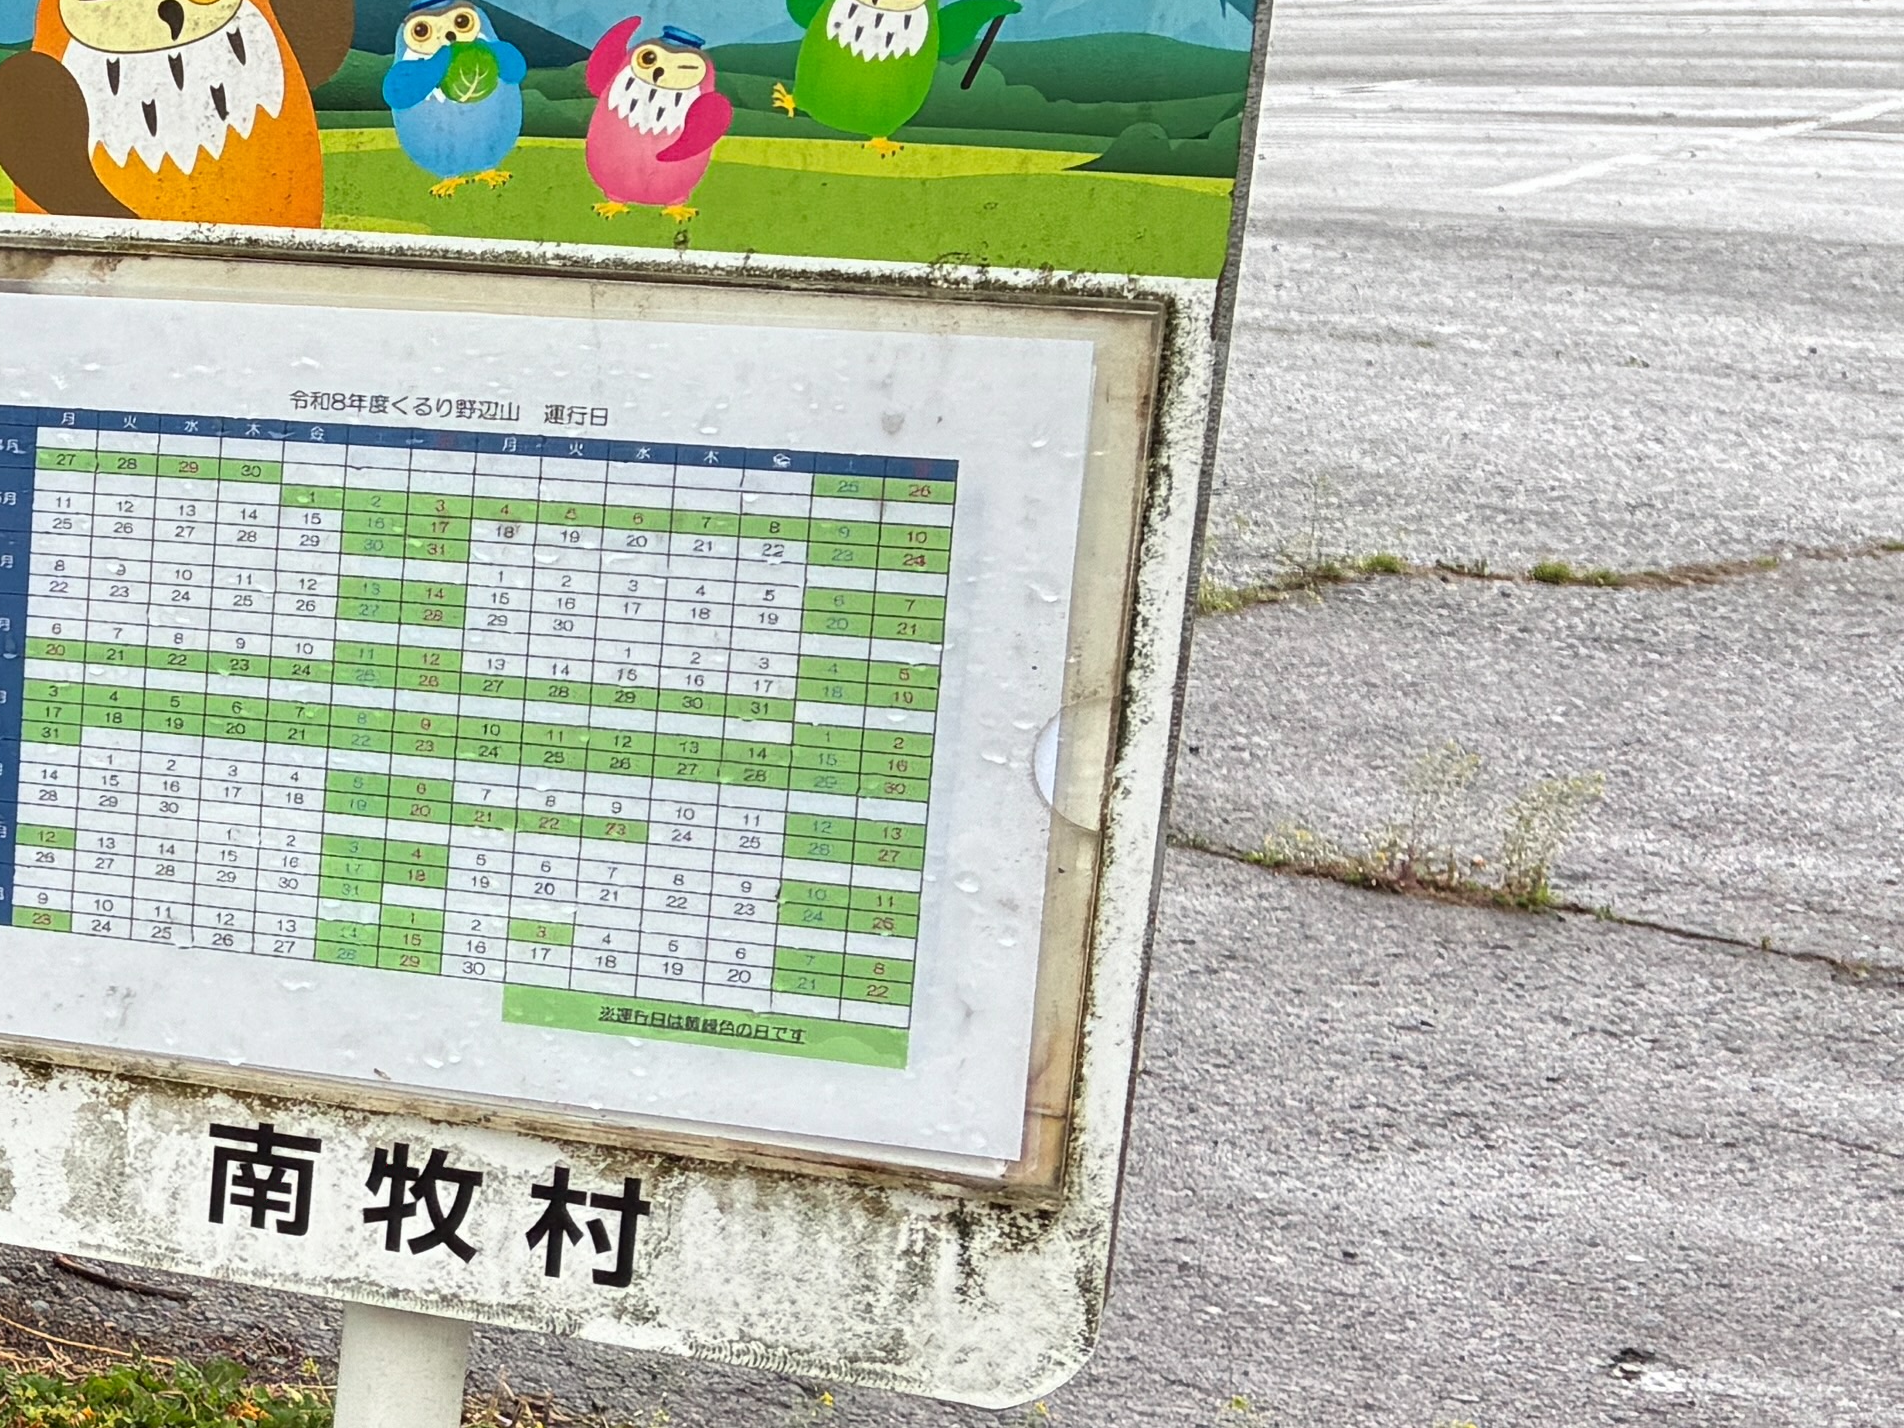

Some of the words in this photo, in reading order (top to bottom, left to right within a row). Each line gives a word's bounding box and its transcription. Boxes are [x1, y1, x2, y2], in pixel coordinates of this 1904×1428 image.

[288, 389, 520, 422] 令和8年度くるり野辺山
[543, 402, 610, 427] 運行日
[51, 516, 73, 530] 25
[112, 520, 134, 535] 26
[173, 524, 196, 538] 27
[236, 528, 258, 543] 28
[298, 533, 321, 548] 29
[55, 495, 71, 509] 11
[116, 499, 134, 514] 12
[178, 503, 197, 517] 13
[239, 507, 258, 521] 14
[303, 511, 322, 525] 15
[560, 529, 581, 544] 19
[625, 534, 648, 548] 20
[692, 538, 713, 553] 21
[760, 542, 784, 558] 22
[47, 579, 69, 594] 22
[108, 584, 130, 599] 23
[170, 588, 191, 603] 24
[232, 593, 254, 608] 25
[295, 598, 316, 613] 26
[486, 612, 508, 627] 29
[551, 618, 575, 633] 30
[53, 558, 66, 572] 8
[174, 568, 194, 582] 10
[236, 572, 252, 586] 11
[298, 577, 318, 591] 12
[557, 596, 576, 610] 16
[622, 601, 642, 615] 17
[690, 606, 712, 621] 18
[758, 611, 779, 626] 19
[694, 584, 707, 597] 4
[761, 588, 776, 602] 5
[50, 621, 62, 636] 6
[172, 631, 184, 645] 8
[234, 636, 246, 650] 9
[295, 641, 314, 655] 10
[487, 657, 506, 671] 13
[551, 662, 570, 677] 14
[685, 673, 705, 687] 16
[753, 678, 775, 694] 17
[290, 663, 311, 676] 24
[688, 650, 702, 665] 2
[105, 710, 123, 725] 18
[224, 722, 246, 735] 20
[286, 727, 306, 741] 21
[481, 722, 501, 737] 10
[37, 788, 59, 802] 28
[97, 794, 119, 808] 29
[158, 799, 180, 814] 30
[40, 768, 59, 781] 14
[101, 773, 120, 787] 15
[162, 779, 181, 793] 16
[223, 785, 242, 799] 17
[285, 791, 305, 805] 18
[670, 830, 693, 843] 24
[165, 758, 177, 772] 2
[289, 770, 300, 783] 4
[543, 794, 557, 808] 8
[610, 800, 623, 815] 9
[675, 805, 696, 821] 10
[742, 812, 760, 827] 11
[34, 850, 56, 864] 26
[93, 856, 115, 870] 27
[154, 862, 176, 877] 28
[215, 869, 237, 884] 29
[277, 876, 300, 891] 30
[97, 836, 116, 850] 13
[158, 842, 176, 856] 14
[219, 849, 238, 863] 15
[471, 874, 490, 889] 19
[598, 887, 619, 902] 21
[664, 894, 688, 910] 22
[732, 901, 756, 917] 23
[285, 833, 297, 848] 2
[539, 859, 552, 874] 6
[671, 873, 685, 887] 8
[739, 879, 753, 894] 9
[36, 891, 49, 906] 9
[93, 898, 114, 913] 10
[154, 904, 174, 921] 11
[215, 911, 235, 927] 12
[277, 918, 297, 933] 13
[466, 938, 487, 955] 16
[530, 946, 552, 961] 17
[594, 954, 617, 969] 18
[662, 961, 684, 976] 19
[726, 967, 752, 984] 20
[90, 918, 112, 933] 24
[149, 924, 173, 940] 25
[211, 932, 234, 947] 26
[272, 938, 296, 954] 27
[461, 960, 486, 976] 30
[470, 918, 482, 932] 2
[601, 932, 612, 946] 4
[734, 946, 747, 960] 6
[205, 1122, 650, 1289] 南牧村
